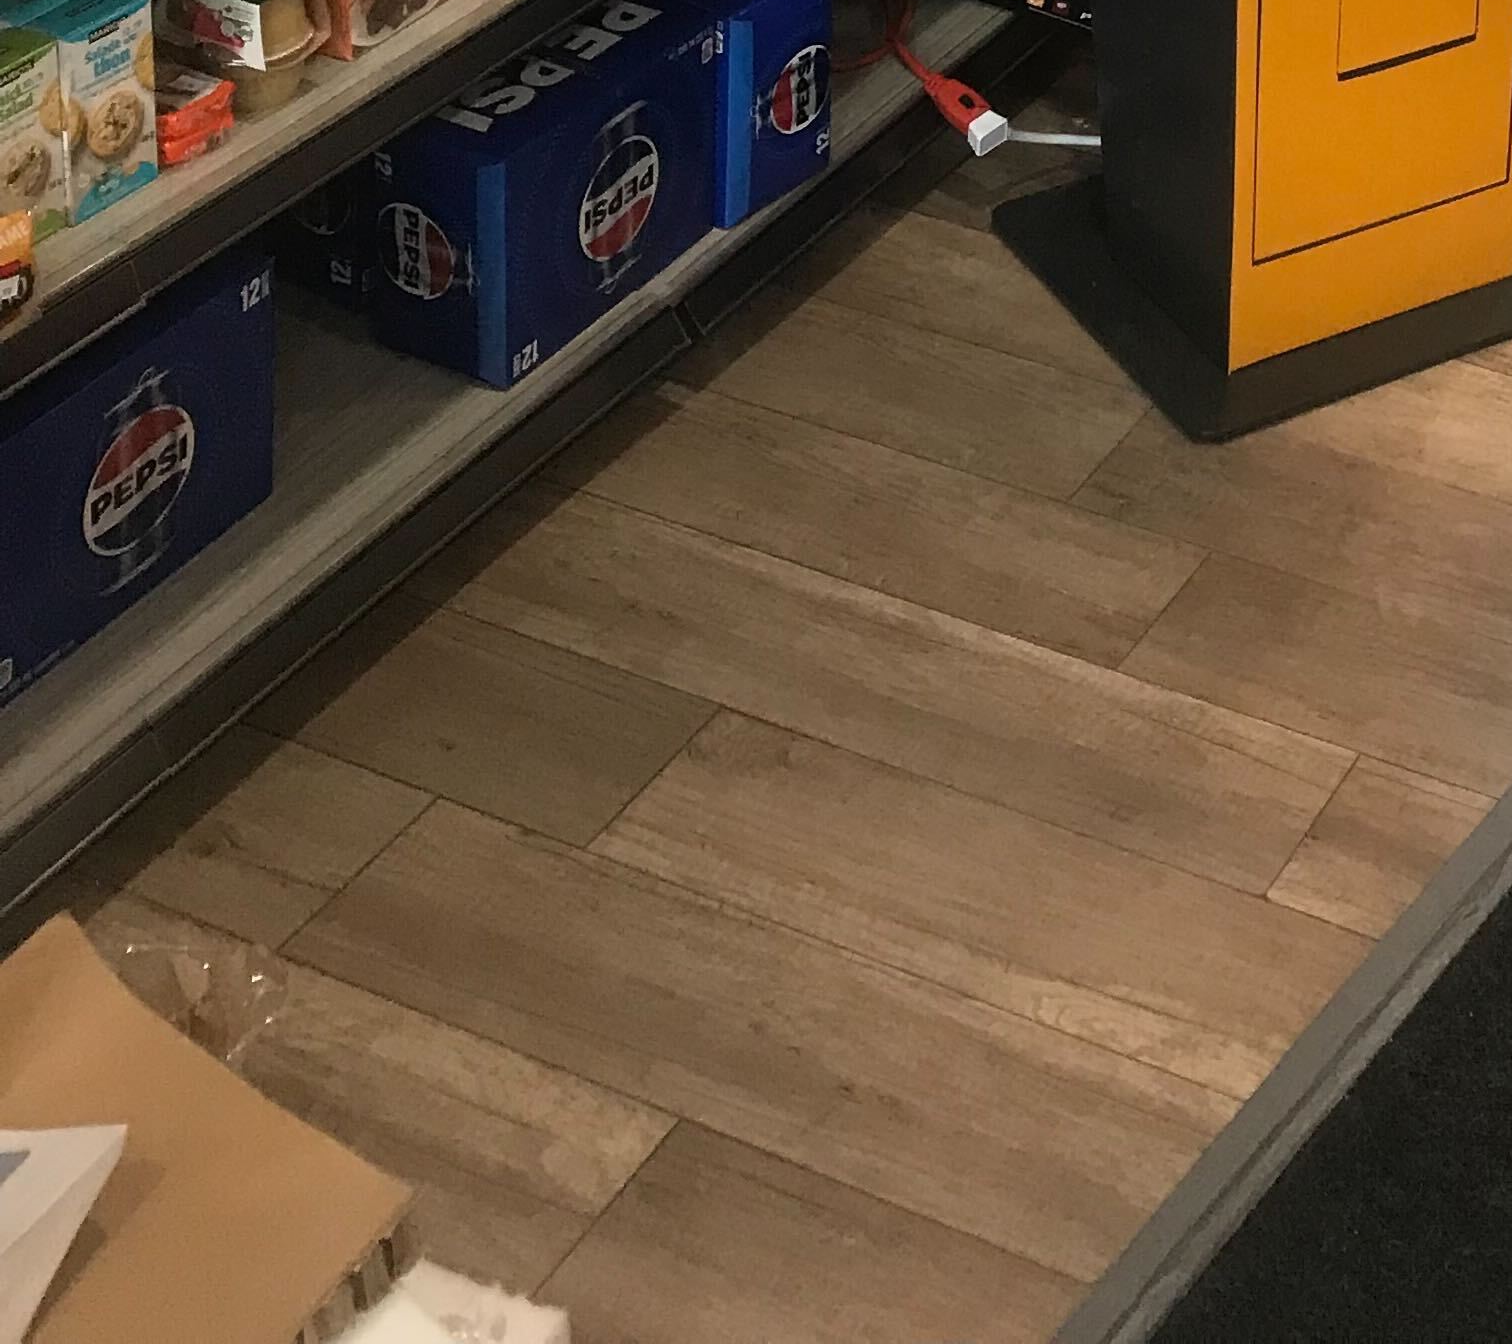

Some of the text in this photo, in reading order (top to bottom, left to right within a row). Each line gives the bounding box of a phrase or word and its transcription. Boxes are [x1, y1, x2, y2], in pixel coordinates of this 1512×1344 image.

[583, 162, 658, 235] PEPSI
[396, 207, 423, 296] PEPSI
[87, 430, 193, 528] PEPSI
